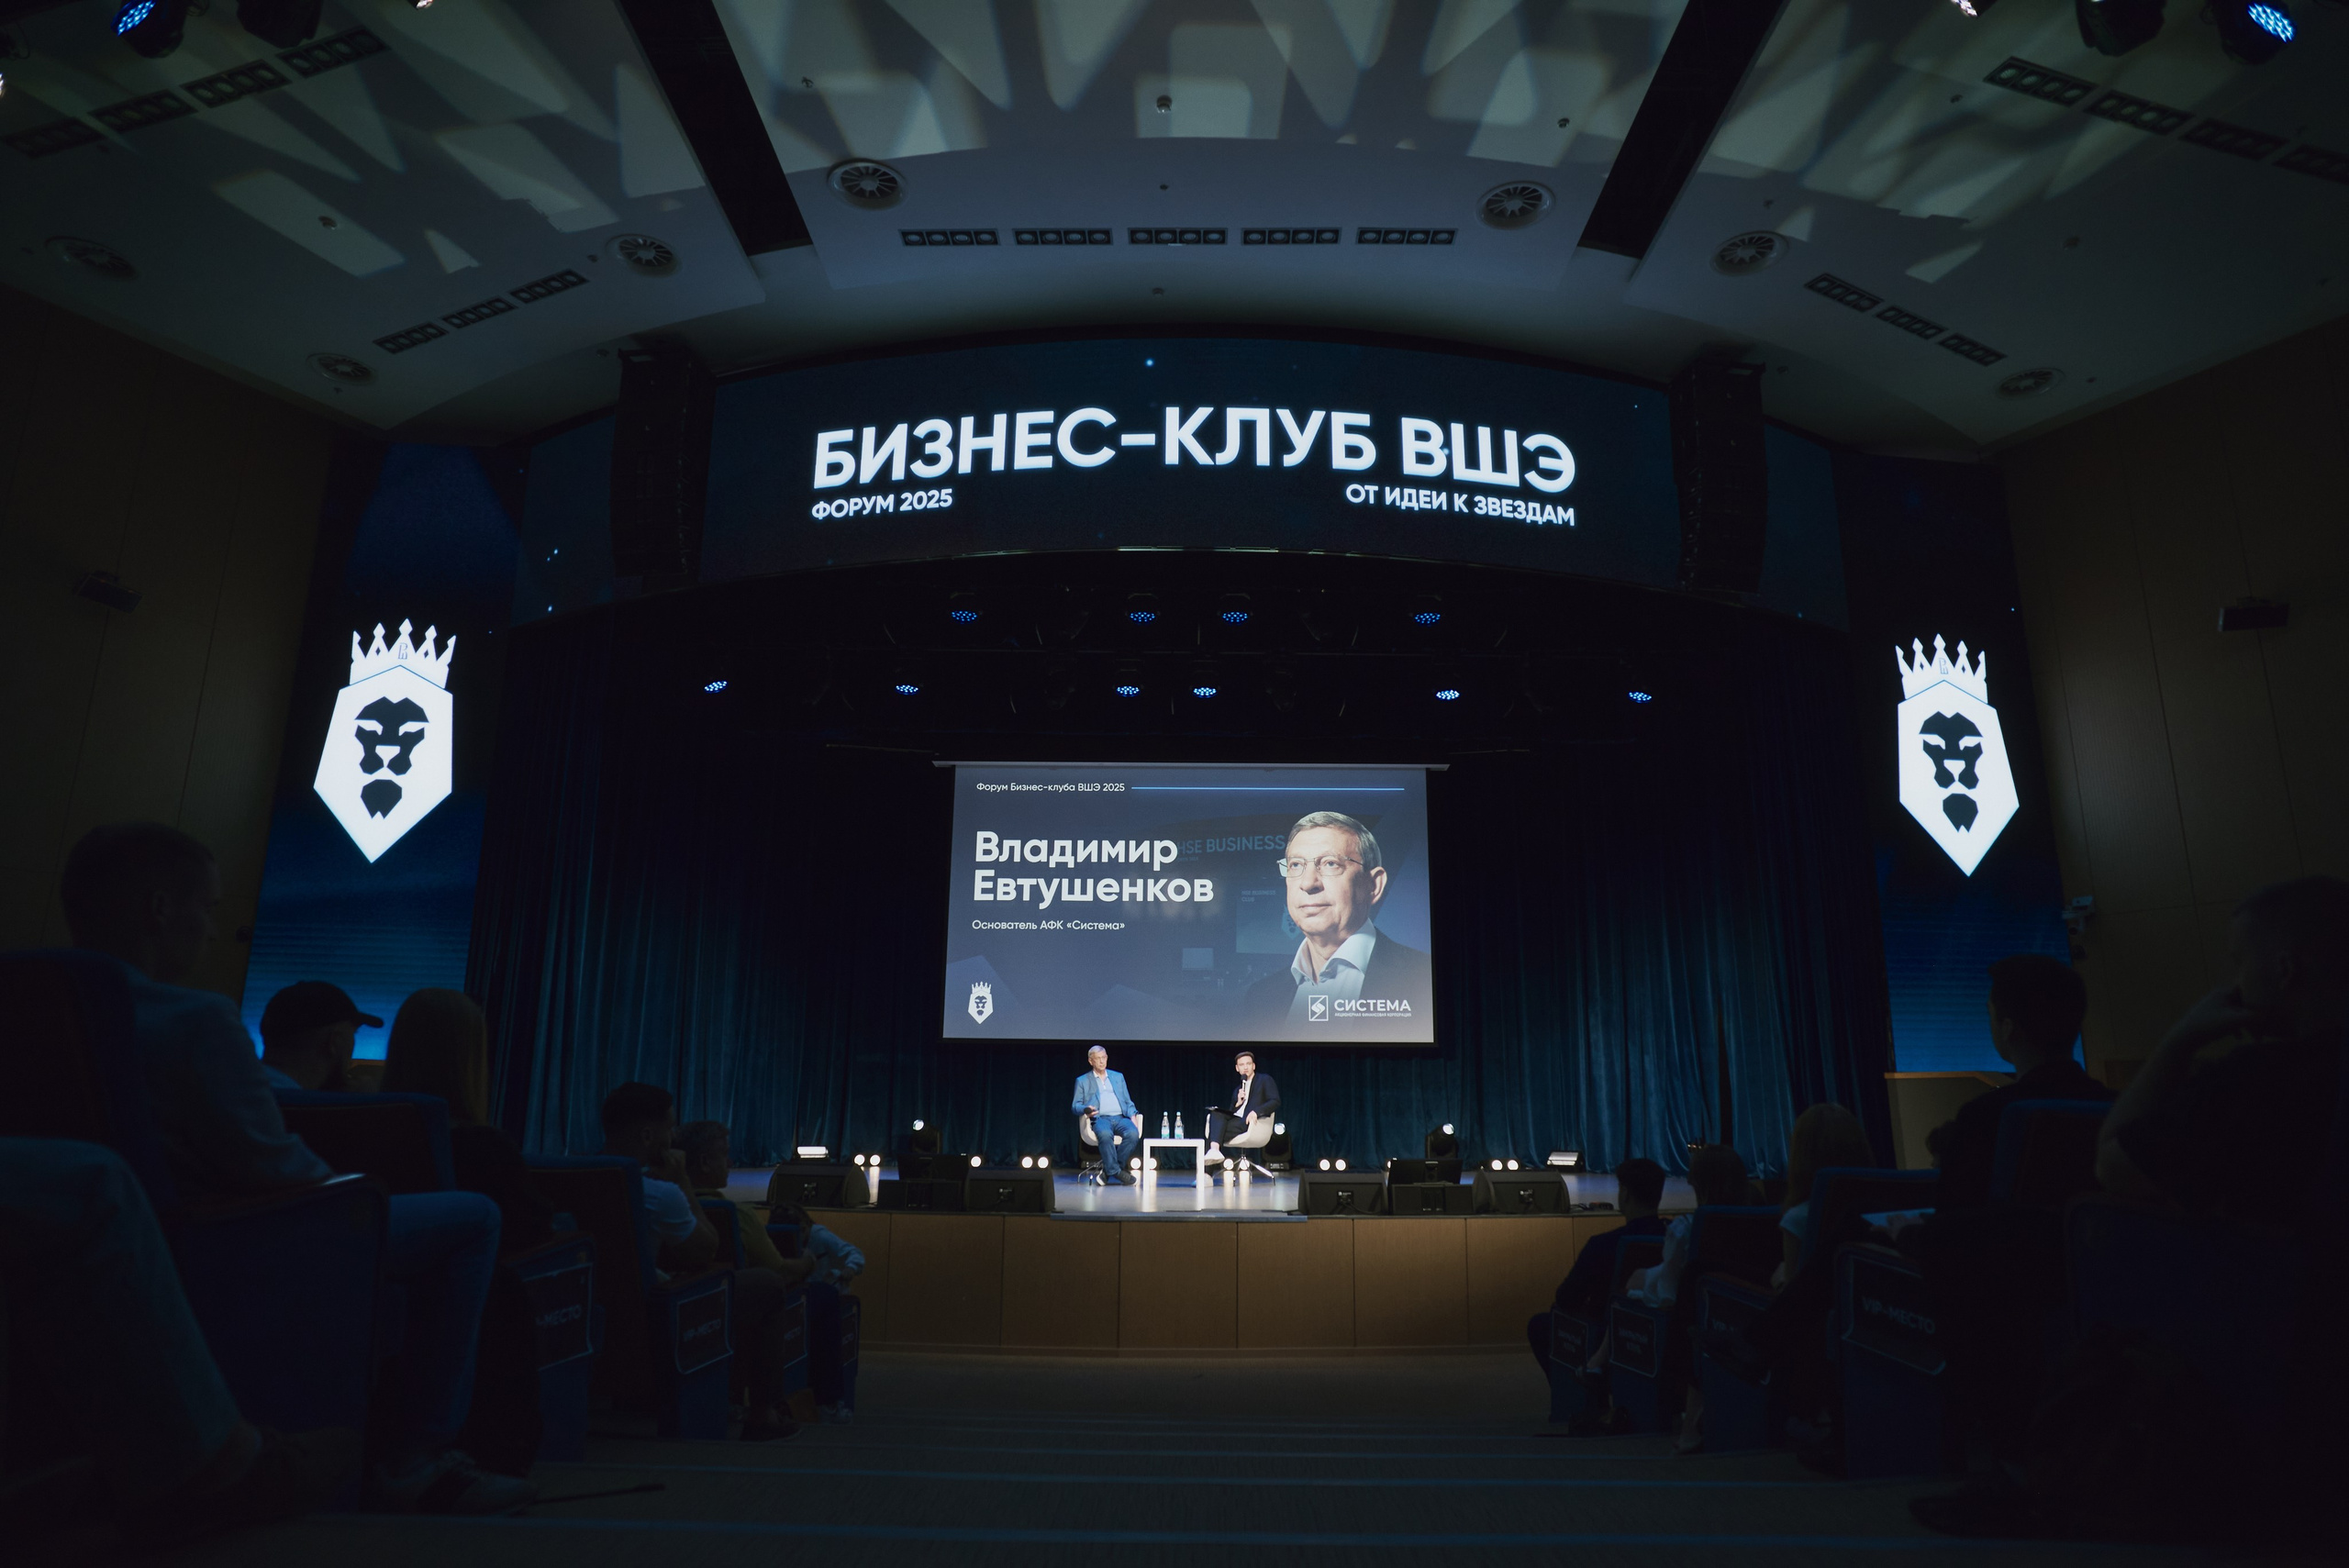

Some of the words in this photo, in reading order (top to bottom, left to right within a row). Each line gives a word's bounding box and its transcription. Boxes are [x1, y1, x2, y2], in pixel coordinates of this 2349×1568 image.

[812, 406, 1378, 491] БИЗНЕС-КЛУБ
[1399, 416, 1576, 495] ВШЭ
[811, 492, 896, 520] ФОРУМ
[899, 488, 953, 512] 2025
[1345, 483, 1379, 505] ОТ
[1385, 485, 1448, 511] ИДЕИ
[1453, 493, 1469, 513] К
[1473, 495, 1575, 527] ЗВЕЗДАМ
[976, 783, 1008, 793] Форум
[1010, 783, 1075, 793] Бизнес-клуба
[1077, 783, 1101, 792] ВШЭ
[1102, 783, 1125, 792] 2025
[975, 830, 1178, 871] Владимир
[1206, 834, 1286, 853] BUSINESS
[974, 869, 1215, 910] Евтушенков
[972, 919, 1038, 929] Основатель
[1040, 919, 1063, 930] АФК
[1066, 920, 1125, 930] «Система»
[1334, 999, 1411, 1012] СИСТЕМА
[1861, 1296, 1936, 1335] VIP-МЕСТО
